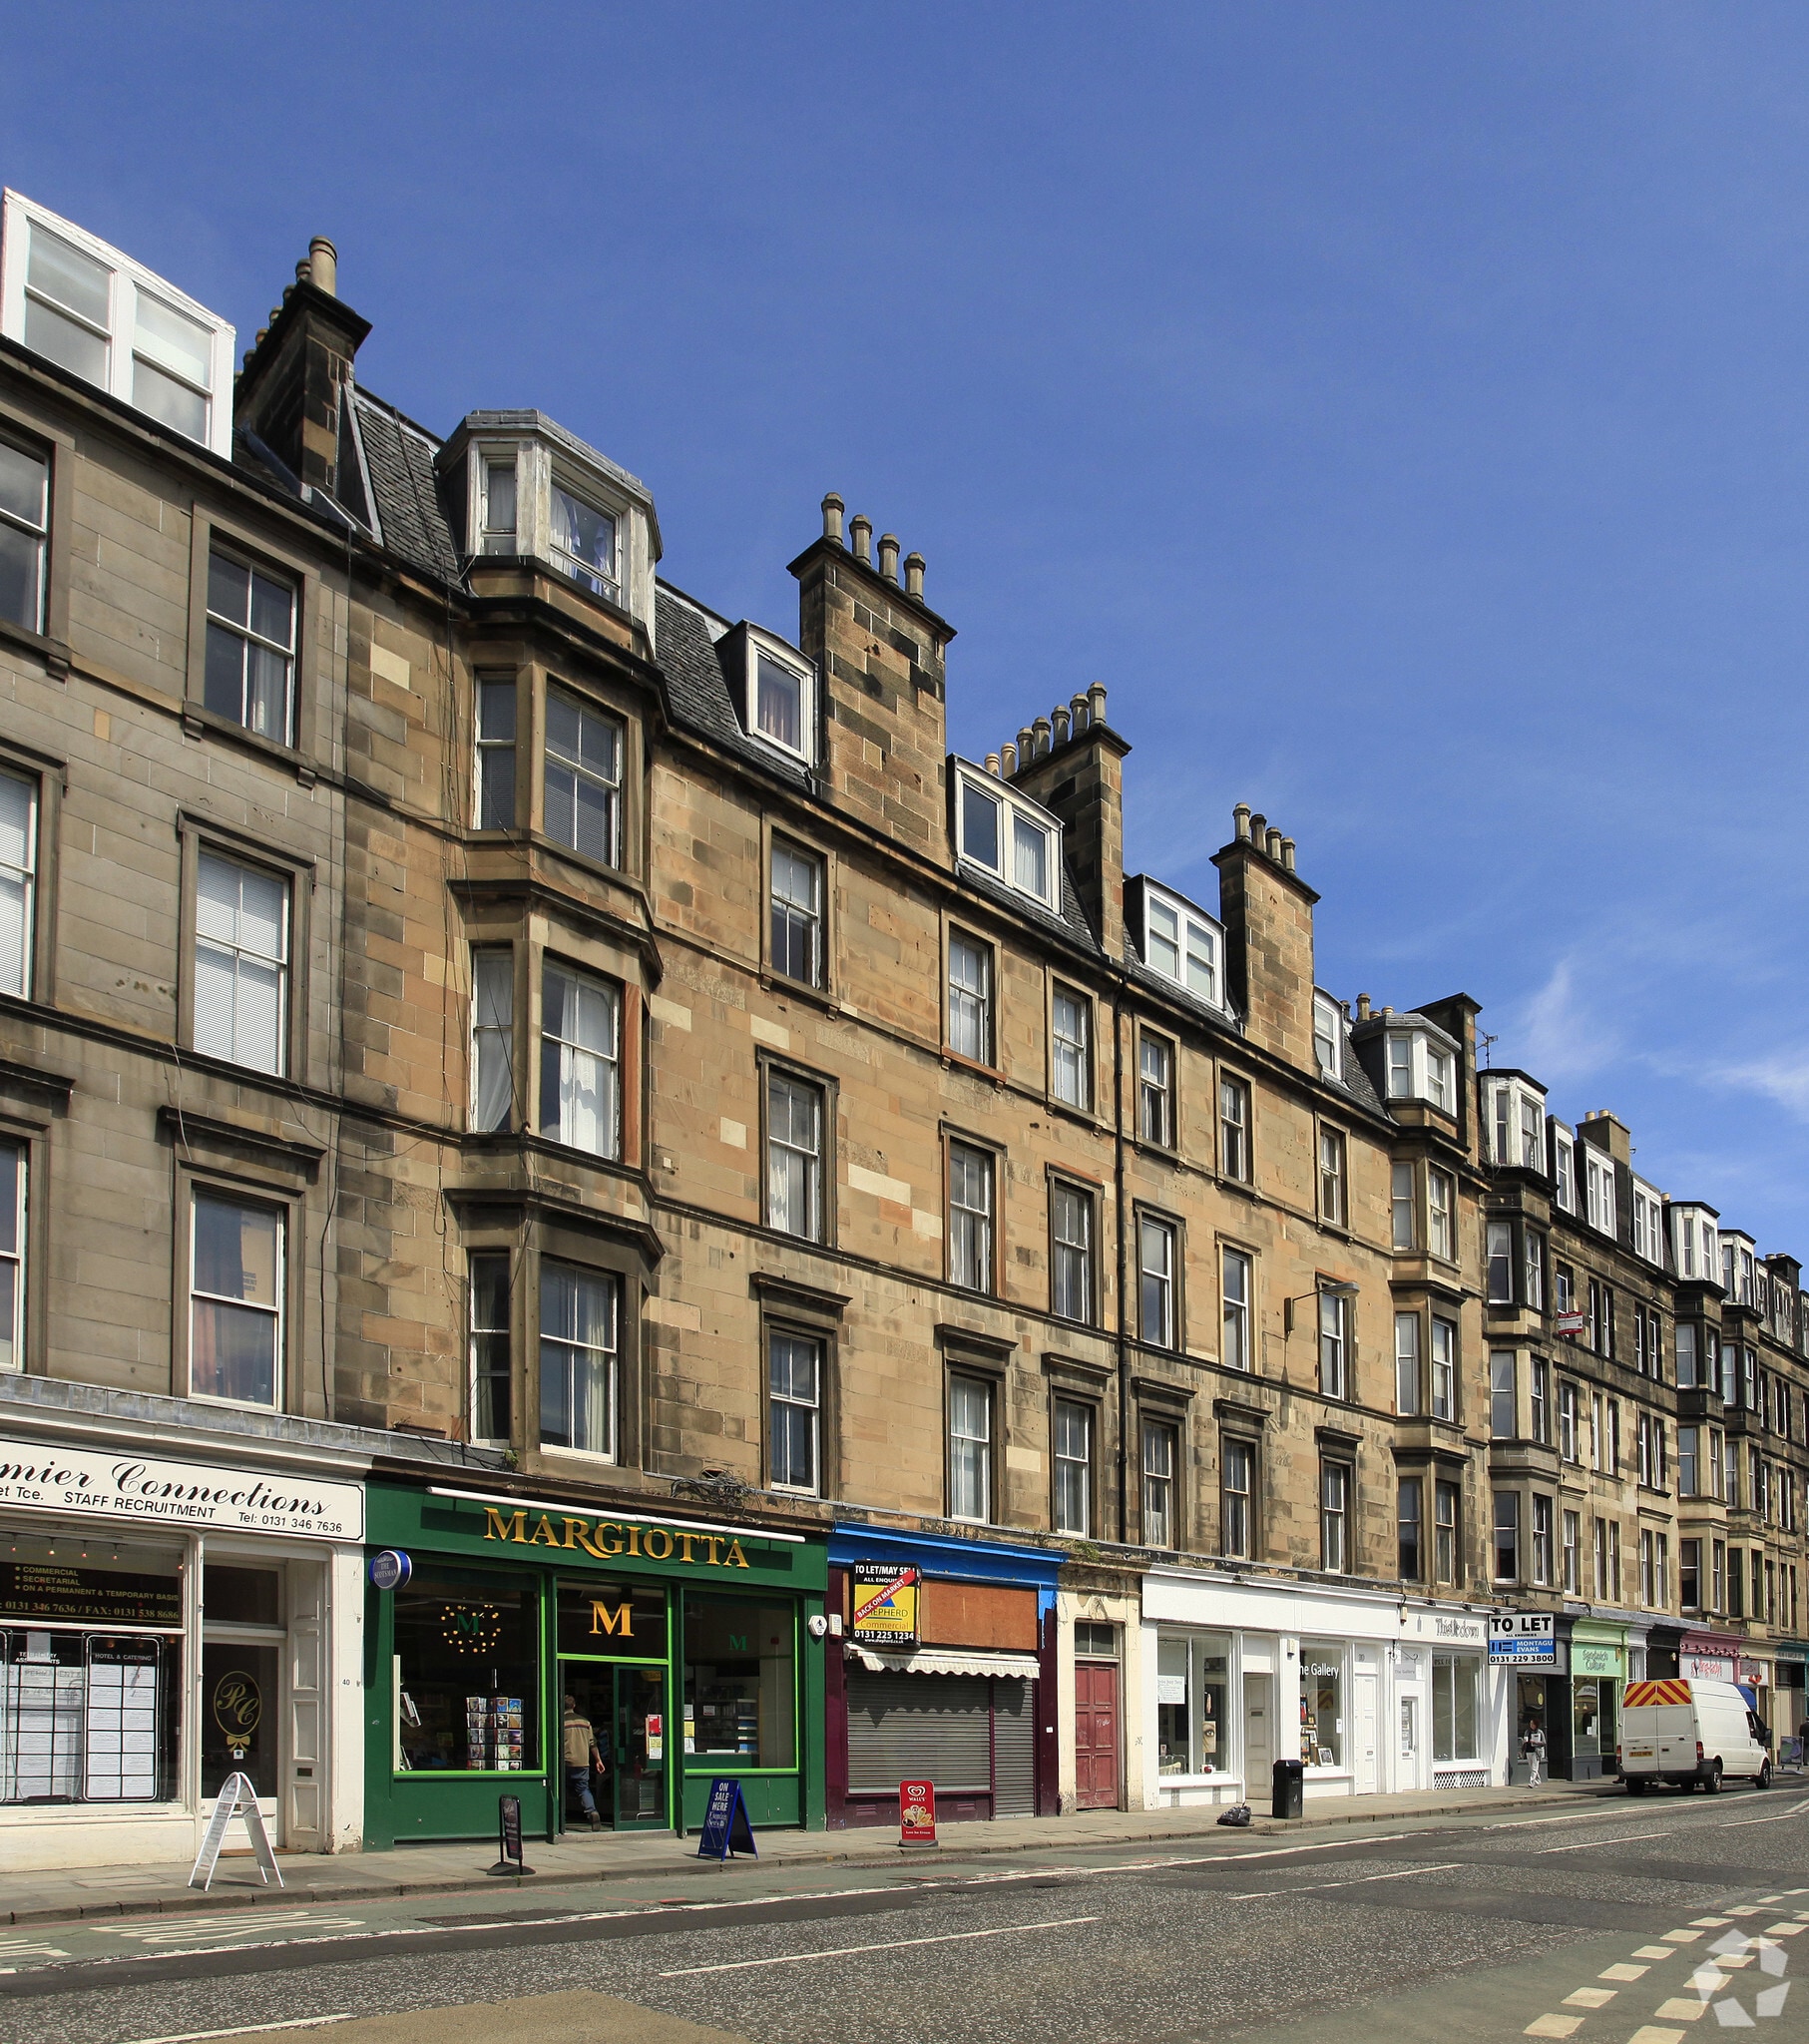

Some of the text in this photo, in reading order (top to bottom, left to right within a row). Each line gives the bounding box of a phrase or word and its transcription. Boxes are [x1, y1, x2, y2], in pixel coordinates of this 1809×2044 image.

[16, 1486, 44, 1500] Tce.
[112, 1462, 331, 1515] Connections
[64, 1491, 217, 1519] STAFF RECRUITMENT
[238, 1511, 342, 1533] Tel: 0131 346 7636
[483, 1507, 749, 1568] MARGIOTTA
[22, 1566, 79, 1577] COMMERCIAL
[855, 1565, 865, 1574] TO
[865, 1565, 898, 1575] LET/MAY
[22, 1575, 81, 1586] SECRETARIAL
[45, 1586, 97, 1596] PERMANENT
[105, 1590, 156, 1600] TEMPORARY
[856, 1579, 906, 1618] BACK ON MARKET
[5, 1601, 29, 1610] 0131
[31, 1602, 50, 1612] 346
[52, 1603, 76, 1614] 7636
[85, 1605, 112, 1615] FAX:
[113, 1607, 136, 1617] 0131
[138, 1608, 156, 1618] 538
[157, 1609, 180, 1620] 8686
[870, 1608, 909, 1618] EPHERD
[456, 1613, 480, 1634] M
[589, 1600, 636, 1637] M
[860, 1621, 909, 1630] Commercial
[1491, 1617, 1552, 1633] TO LET
[728, 1634, 747, 1651] M
[854, 1630, 915, 1641] 0131 225 1234
[1299, 1663, 1339, 1680] he Gallery
[718, 1783, 729, 1791] ON
[714, 1791, 729, 1801] SALE
[711, 1801, 728, 1811] HERE
